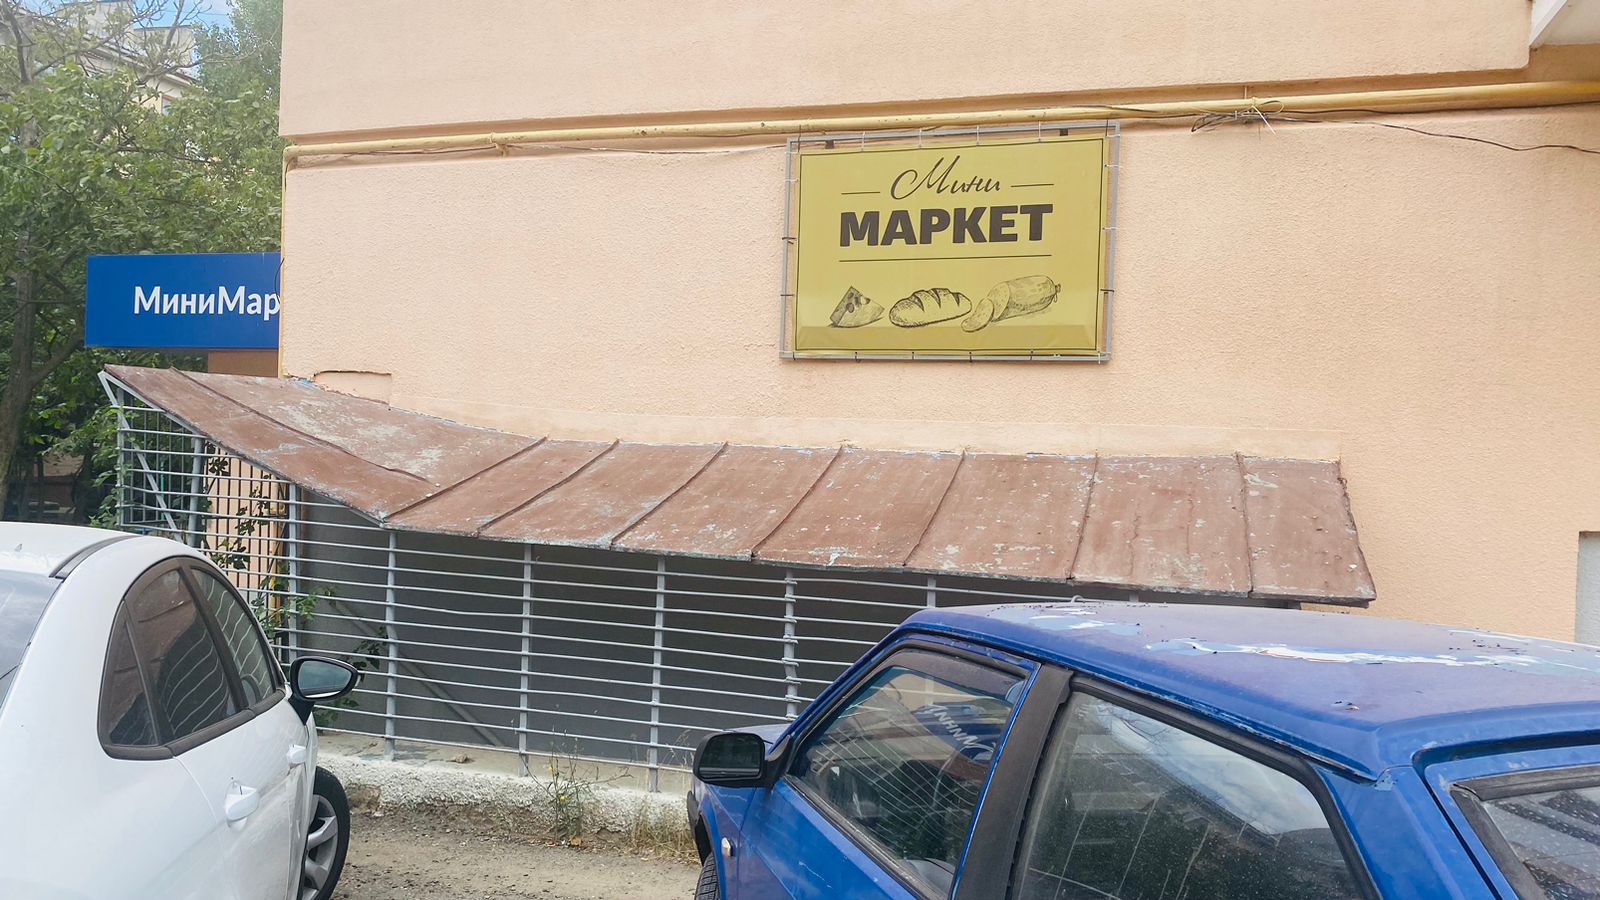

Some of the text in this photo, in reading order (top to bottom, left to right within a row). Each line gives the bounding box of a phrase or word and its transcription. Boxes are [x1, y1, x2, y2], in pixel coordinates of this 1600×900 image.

[891, 155, 1001, 200] Мини
[839, 203, 1053, 247] МАРКЕТ
[133, 285, 280, 321] МиниМар
